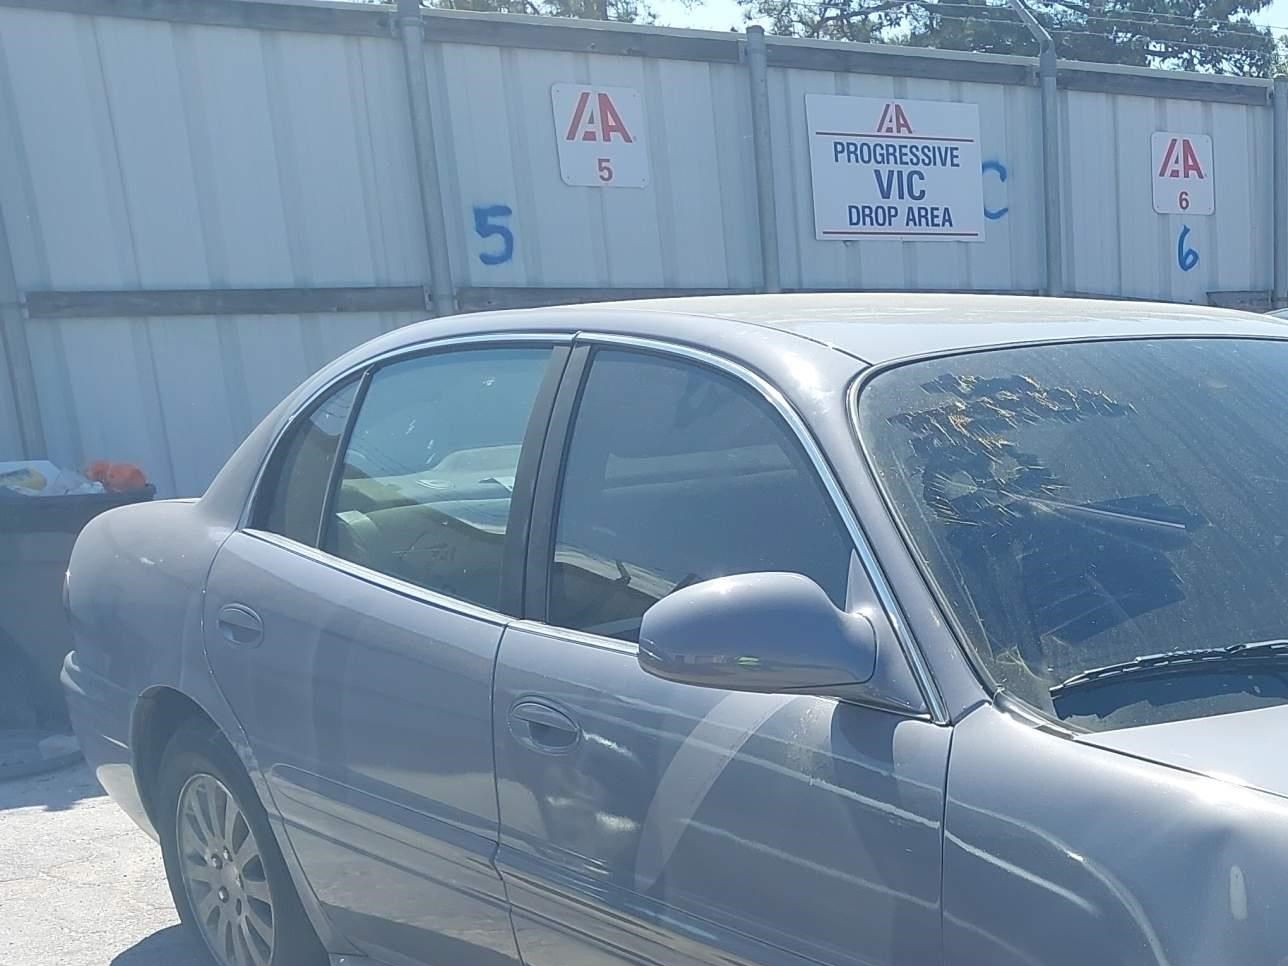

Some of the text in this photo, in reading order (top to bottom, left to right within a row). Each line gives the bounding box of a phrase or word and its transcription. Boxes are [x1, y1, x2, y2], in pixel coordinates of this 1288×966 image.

[833, 141, 960, 168] PROGRESSIVE
[597, 158, 613, 182] 5
[874, 169, 926, 201] VIC
[1178, 191, 1189, 210] 6
[847, 204, 954, 229] DROP AREA
[473, 204, 514, 266] 5
[1177, 226, 1199, 272] 6
